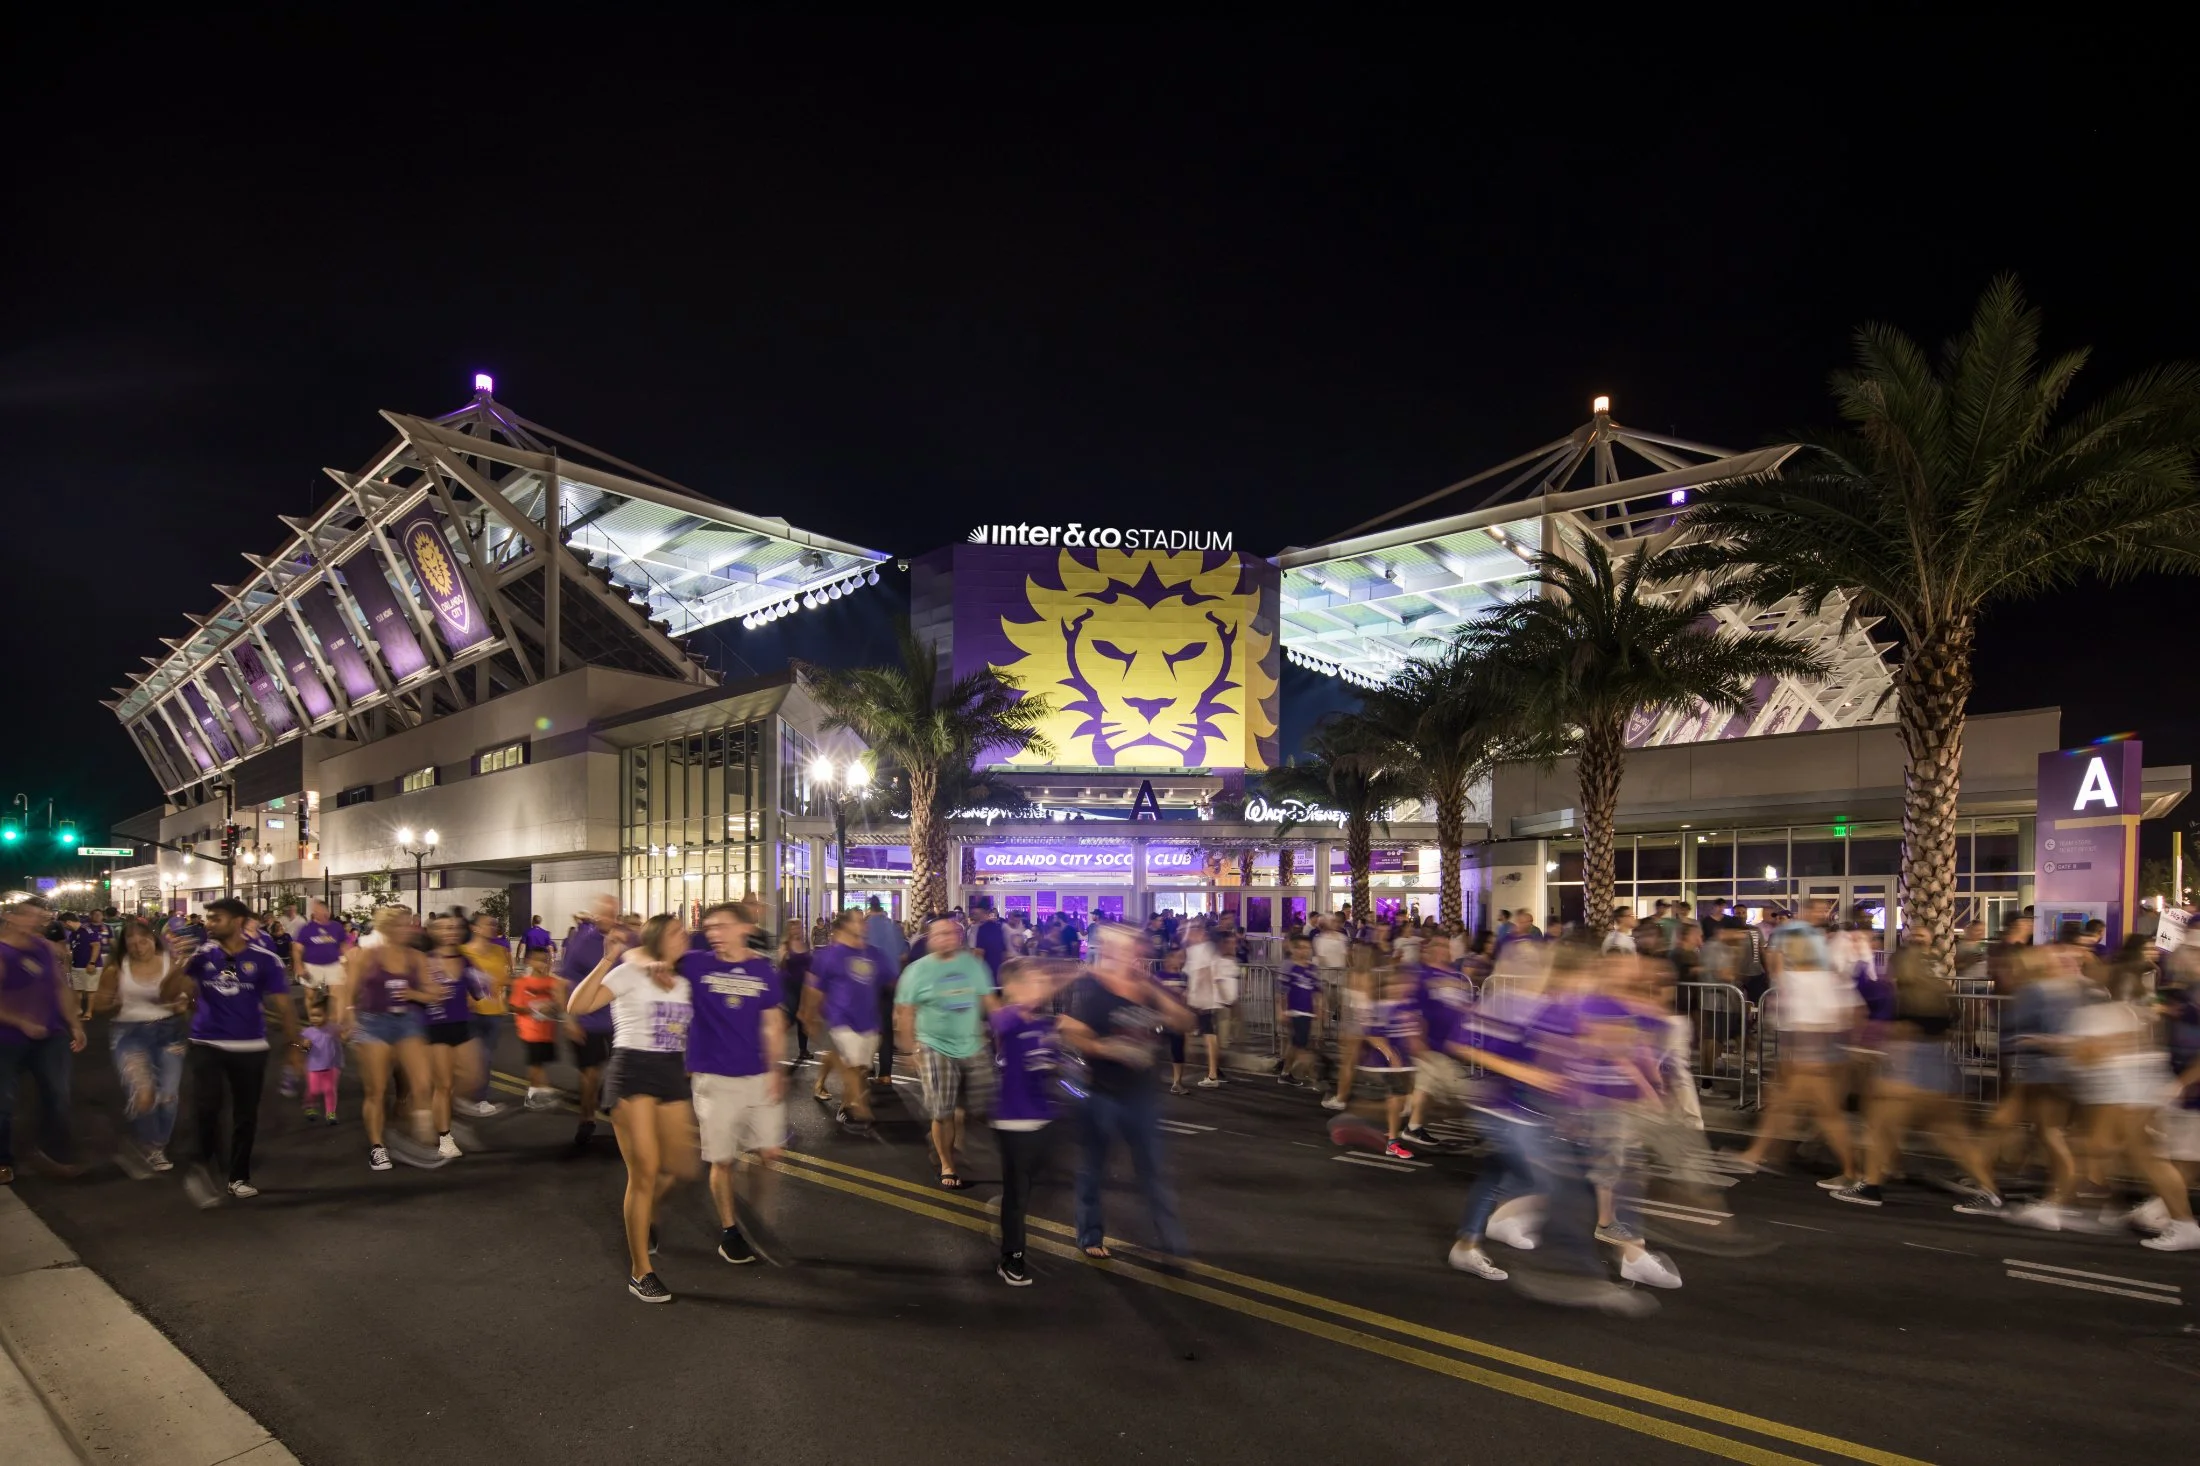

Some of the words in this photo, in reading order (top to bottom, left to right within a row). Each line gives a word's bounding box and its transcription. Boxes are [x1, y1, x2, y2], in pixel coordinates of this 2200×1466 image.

[1124, 528, 1233, 551] STADIUM
[441, 594, 464, 612] ORLANDO
[2073, 756, 2119, 811] A
[1128, 779, 1163, 821] A
[985, 853, 1057, 866] ORLANDO
[1060, 853, 1092, 866] CITY
[1154, 853, 1192, 866] CLUB
